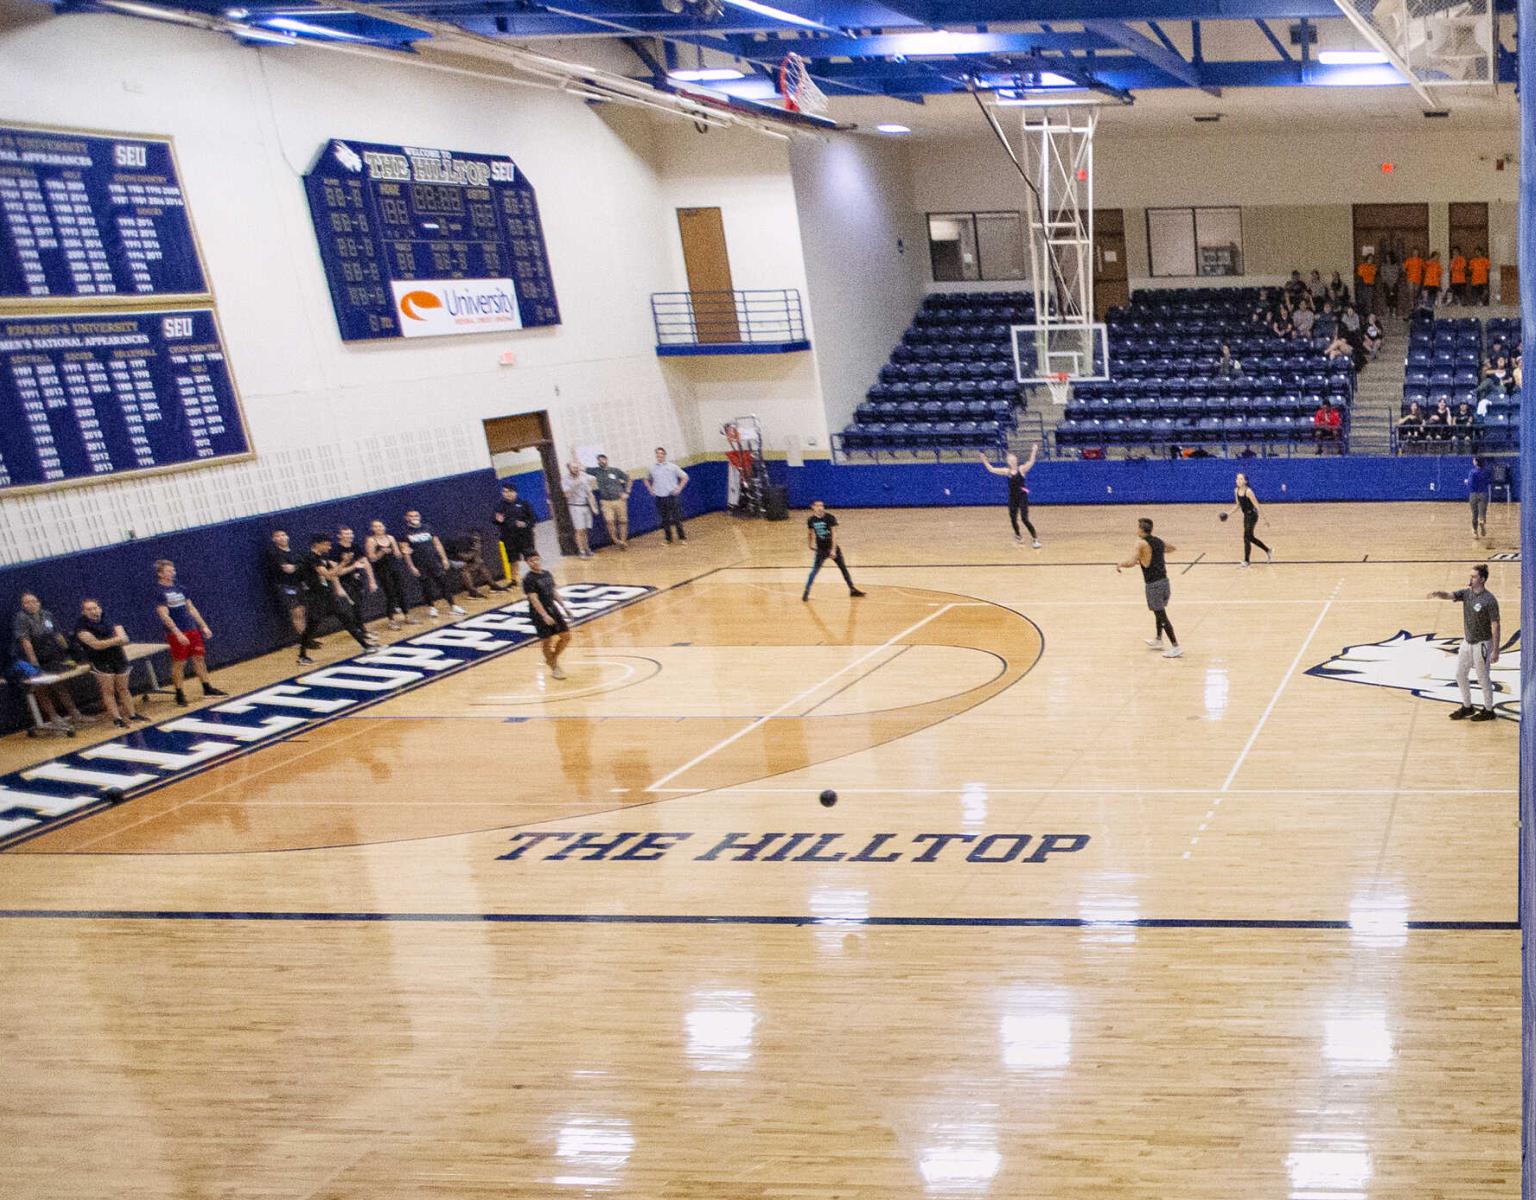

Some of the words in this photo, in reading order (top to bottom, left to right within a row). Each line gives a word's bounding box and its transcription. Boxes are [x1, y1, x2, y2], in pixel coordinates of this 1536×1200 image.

[115, 145, 147, 167] SEU
[364, 151, 411, 180] THE
[410, 155, 491, 187] HILLTOP
[490, 160, 515, 182] SEU
[444, 287, 515, 319] University
[72, 322, 138, 334] UNIVERSITY
[163, 318, 193, 339] SEU
[32, 337, 81, 349] NATIONAL
[83, 334, 151, 347] APPEARANCES
[495, 832, 693, 861] THE
[694, 832, 1091, 863] HILLTOP
